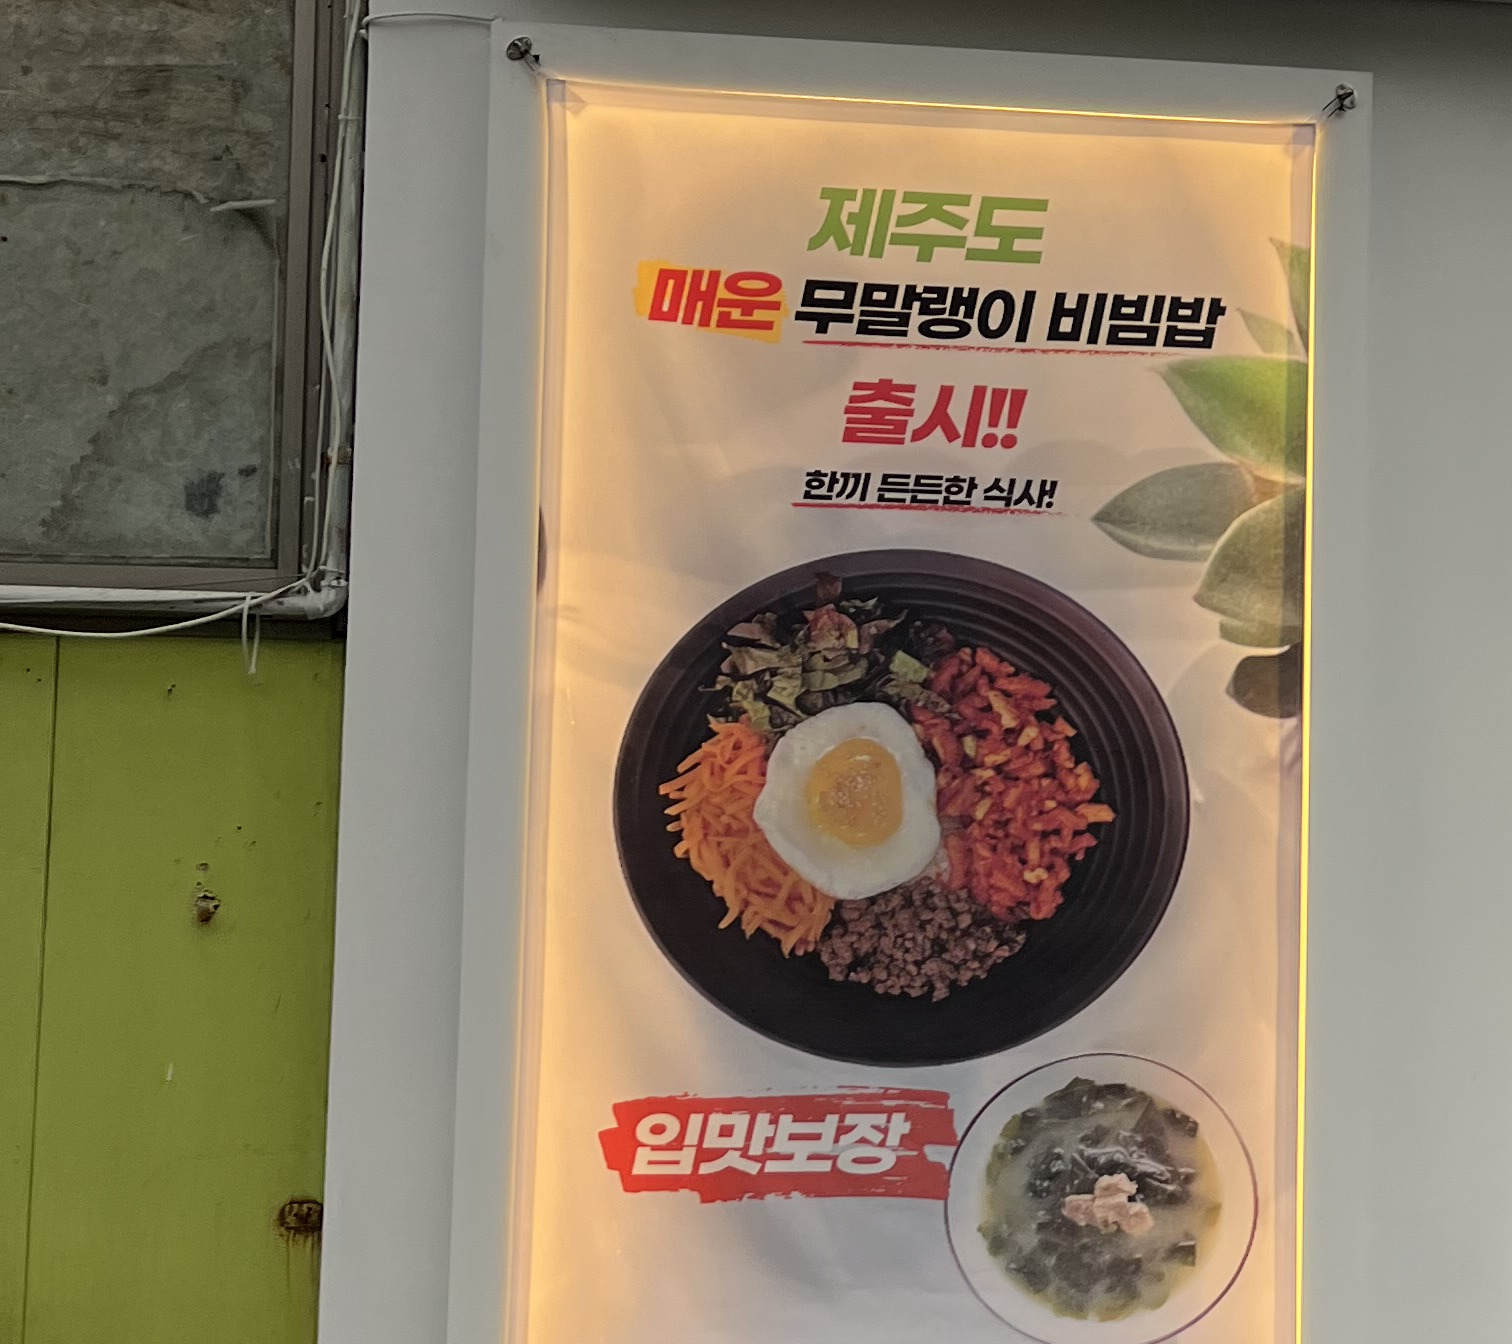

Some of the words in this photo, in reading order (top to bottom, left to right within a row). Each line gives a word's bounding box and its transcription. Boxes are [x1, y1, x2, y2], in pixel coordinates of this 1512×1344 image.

[807, 186, 1050, 265] 제주도
[648, 268, 783, 332] 매운
[795, 280, 1036, 344] 무말랭이
[1046, 291, 1226, 350] 비빔밥
[841, 378, 1028, 451] 출시!!
[802, 468, 869, 503] 한끼
[877, 474, 978, 507] 든든한
[982, 477, 1058, 510] 식사!
[631, 1111, 911, 1176] 입맛보장
